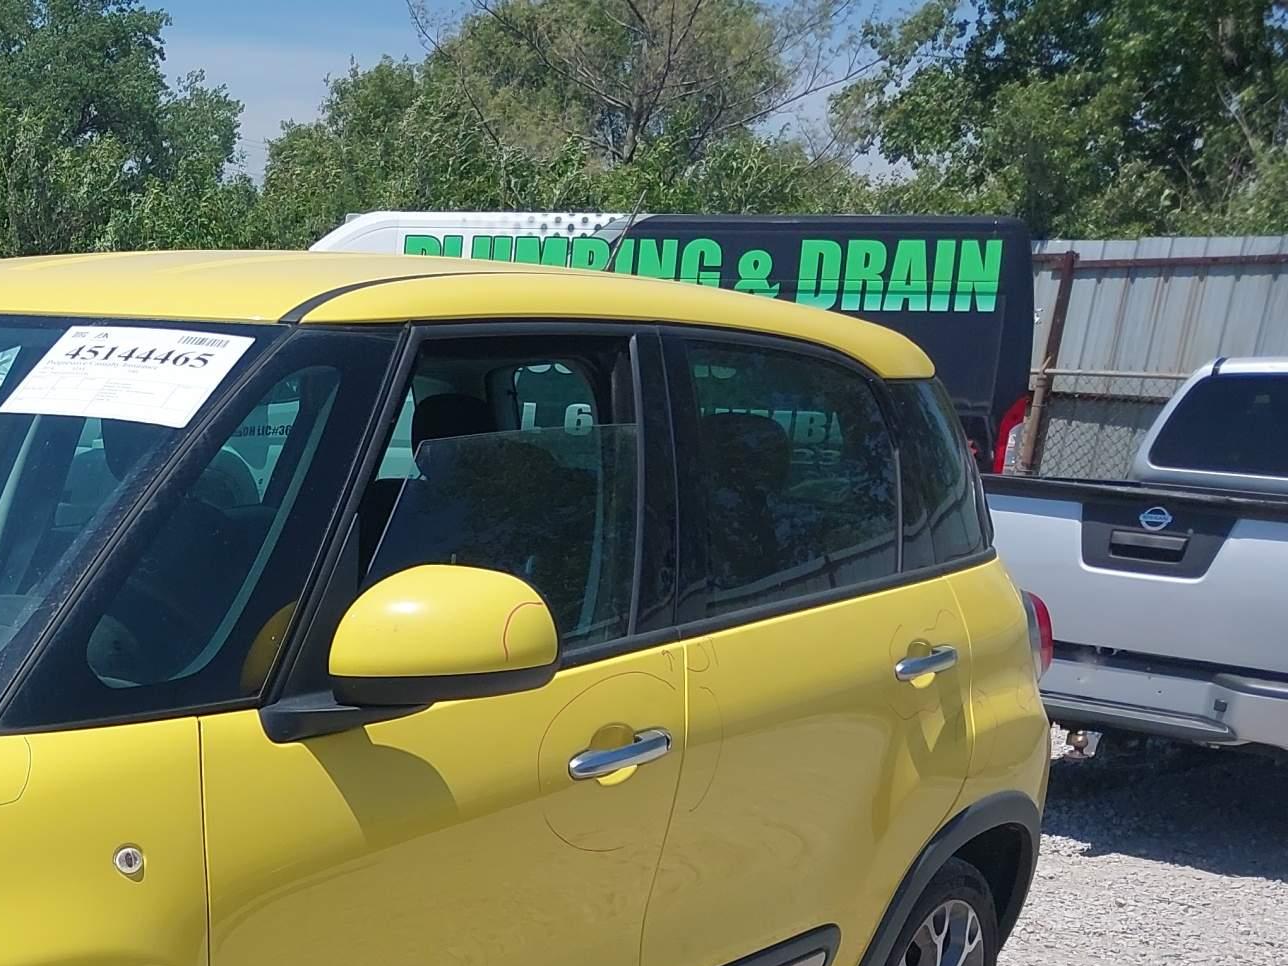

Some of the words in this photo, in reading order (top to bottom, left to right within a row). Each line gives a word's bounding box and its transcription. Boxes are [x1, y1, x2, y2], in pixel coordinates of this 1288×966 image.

[734, 250, 780, 298] &
[796, 239, 1003, 312] DRAIN
[65, 344, 215, 369] 45144465
